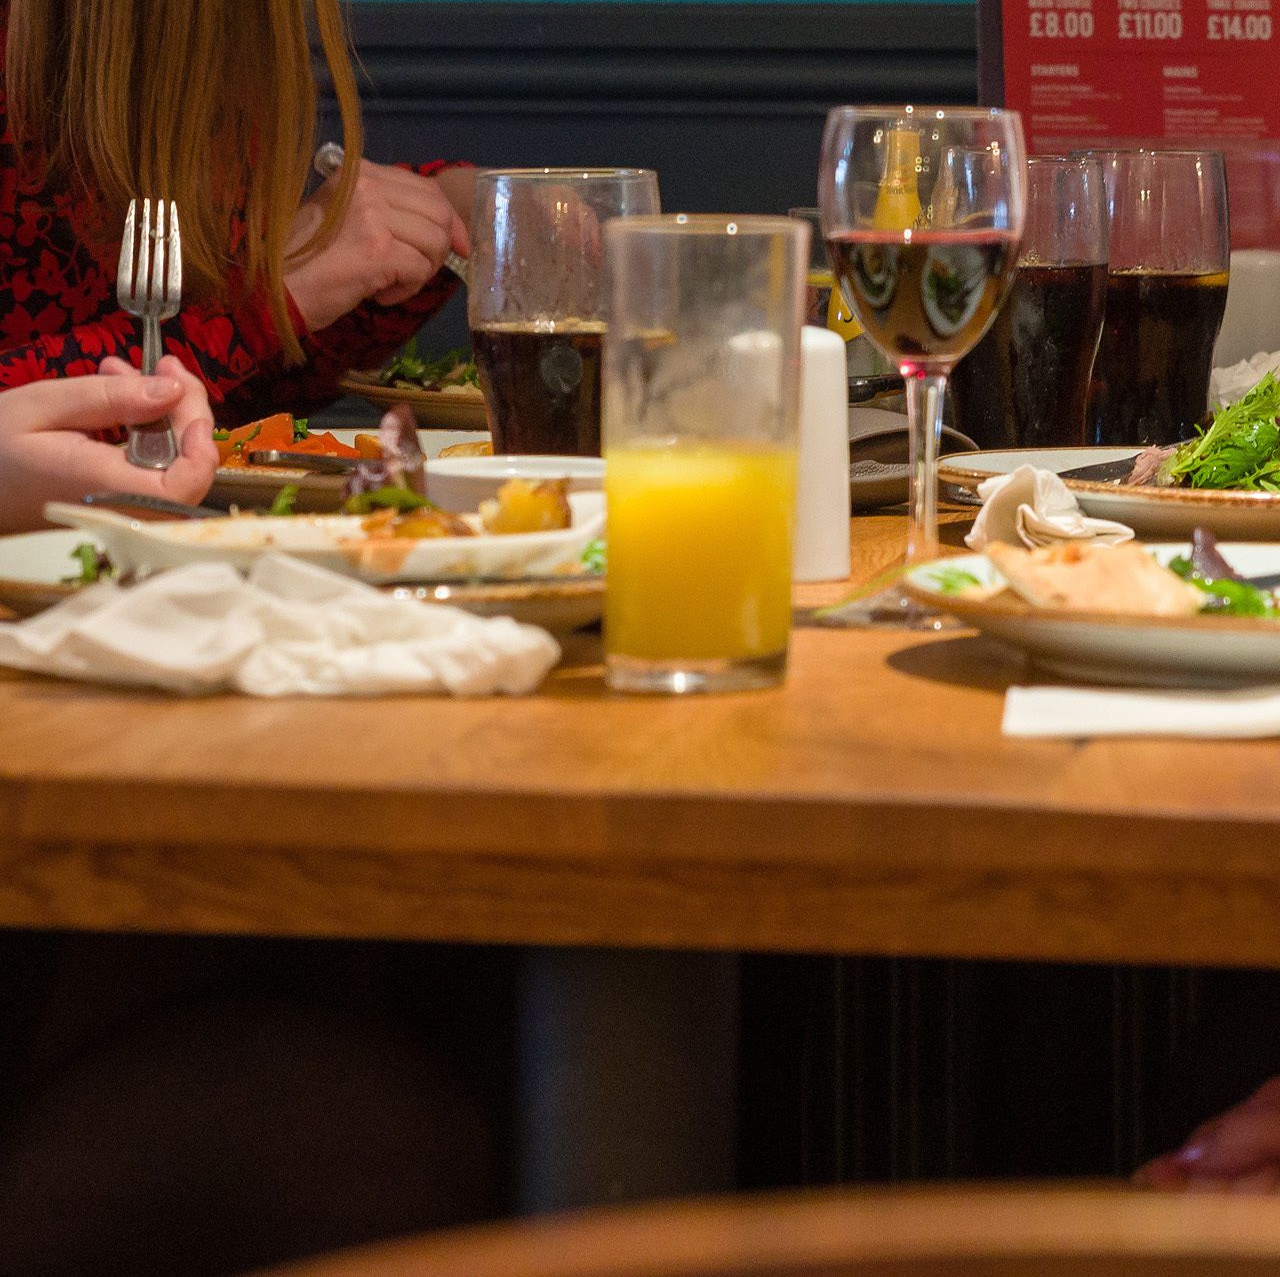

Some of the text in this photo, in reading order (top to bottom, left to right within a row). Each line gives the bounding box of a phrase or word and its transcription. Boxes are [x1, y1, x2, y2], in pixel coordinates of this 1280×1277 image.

[1029, 11, 1094, 38] £8.00
[1118, 12, 1182, 39] £11.00
[1207, 14, 1272, 41] £14.00
